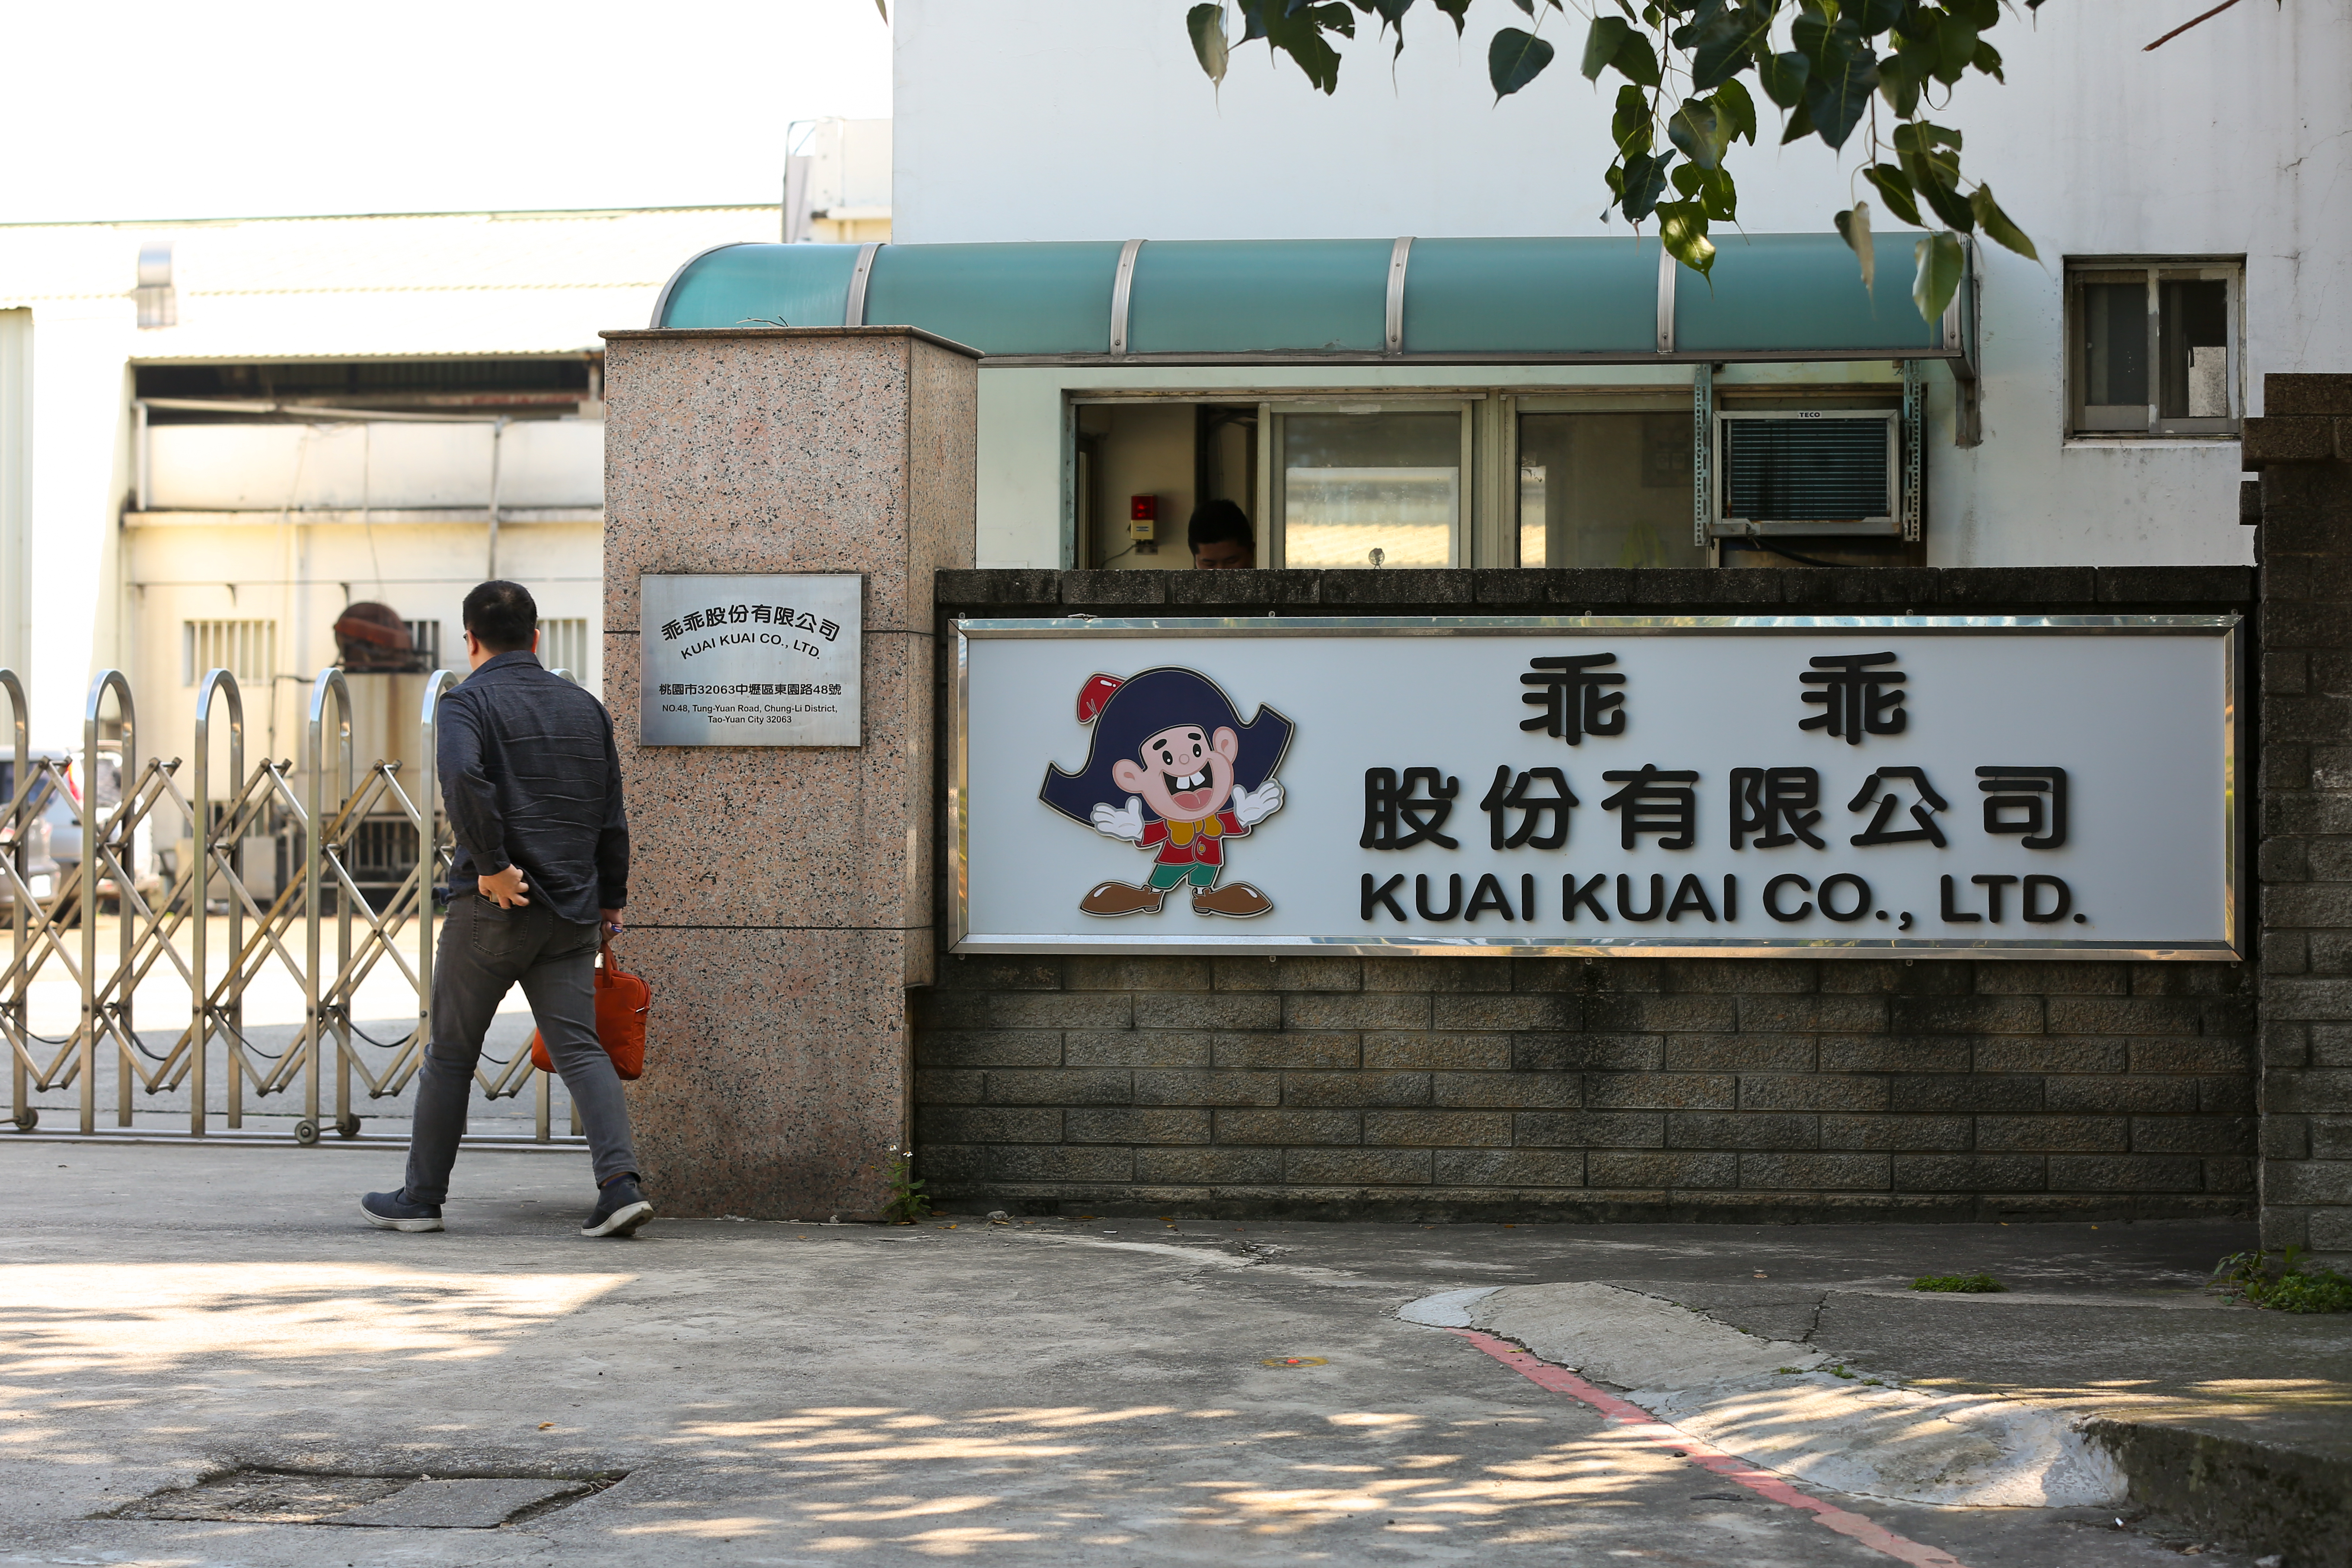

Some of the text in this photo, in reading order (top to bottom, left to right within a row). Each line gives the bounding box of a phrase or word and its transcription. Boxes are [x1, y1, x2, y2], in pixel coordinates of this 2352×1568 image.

[661, 604, 840, 642] 乖乖股份有限公司
[681, 633, 820, 660] KUAI KUAI CO., LTD.
[659, 683, 841, 695] 桃園市32063中壢區東園路48號
[662, 704, 837, 714] NO.48, Tung-Yuan Road, Chung-Li District,
[748, 715, 764, 725] City
[1359, 763, 2069, 851] 股份有限公司
[1360, 872, 2087, 931] KUAI KUAI CO., LTD.
